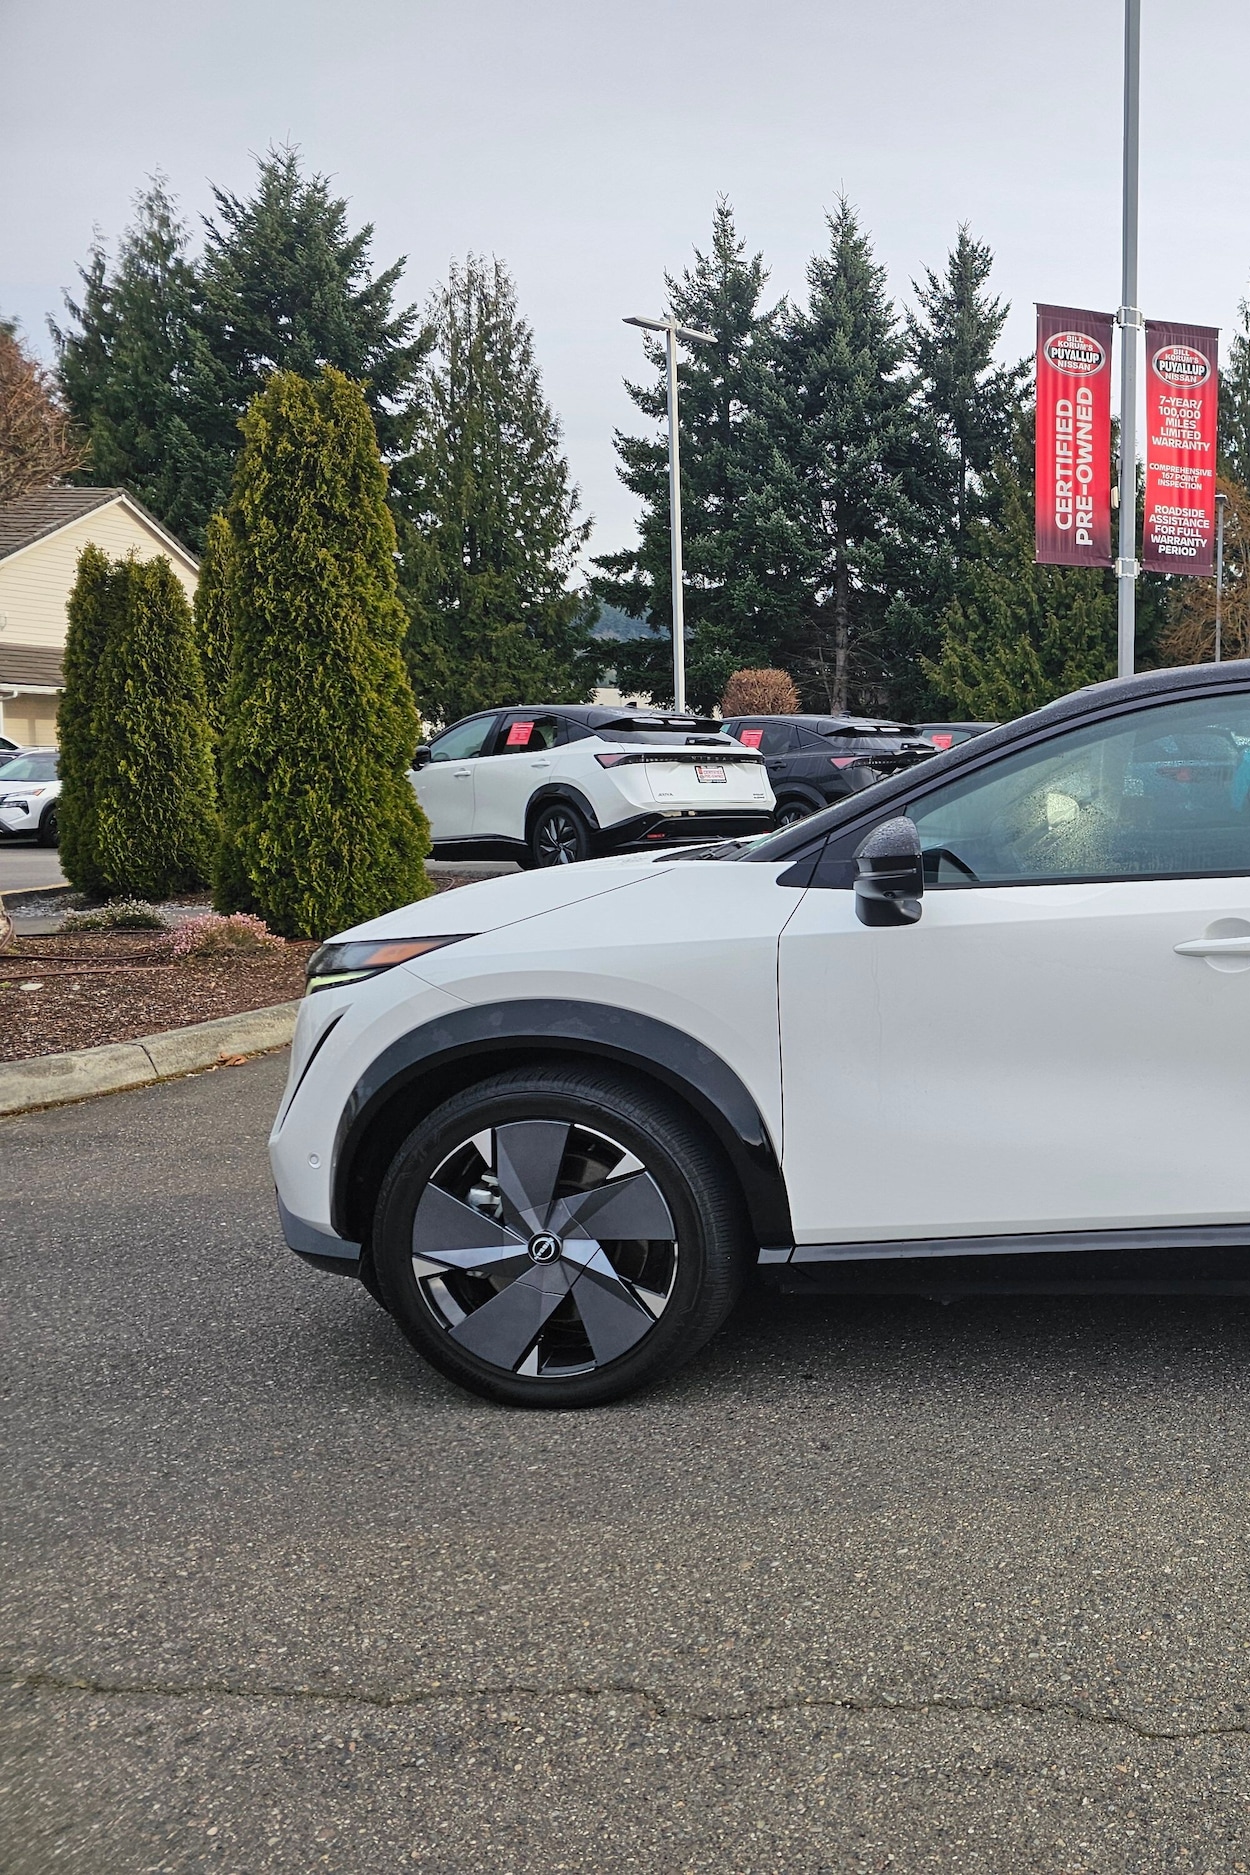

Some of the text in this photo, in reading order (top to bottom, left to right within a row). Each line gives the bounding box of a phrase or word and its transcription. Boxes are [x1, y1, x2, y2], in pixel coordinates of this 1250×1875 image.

[1057, 340, 1093, 351] KORUM'S
[1066, 335, 1084, 343] BILL
[1051, 347, 1100, 364] PUYALLUP
[1165, 353, 1199, 364] KORUM'S
[1173, 348, 1190, 356] BILL
[1057, 360, 1091, 371] NISSAN
[1159, 360, 1206, 376] PUYALLUP
[1164, 372, 1197, 383] NISSAN
[1160, 395, 1203, 410] 7-YEAR/
[1158, 405, 1201, 420] 100,000
[1165, 417, 1197, 429] MILES
[1160, 426, 1202, 440] LIMITED
[1151, 435, 1211, 452] WARRANTY
[1055, 399, 1073, 530] CERTIFIED
[1076, 386, 1093, 546] PRE-OWNED
[1149, 462, 1213, 477] COMPREHENSIVE
[1157, 478, 1203, 490] INSPECTION
[1162, 472, 1199, 482] 167 POINT
[1154, 504, 1205, 519] ROADSIDE
[1149, 514, 1210, 529] ASSISTANCE
[1154, 524, 1202, 538] FOR FULL
[1150, 533, 1208, 548] WARRANTY
[1158, 544, 1197, 557] PERIOD
